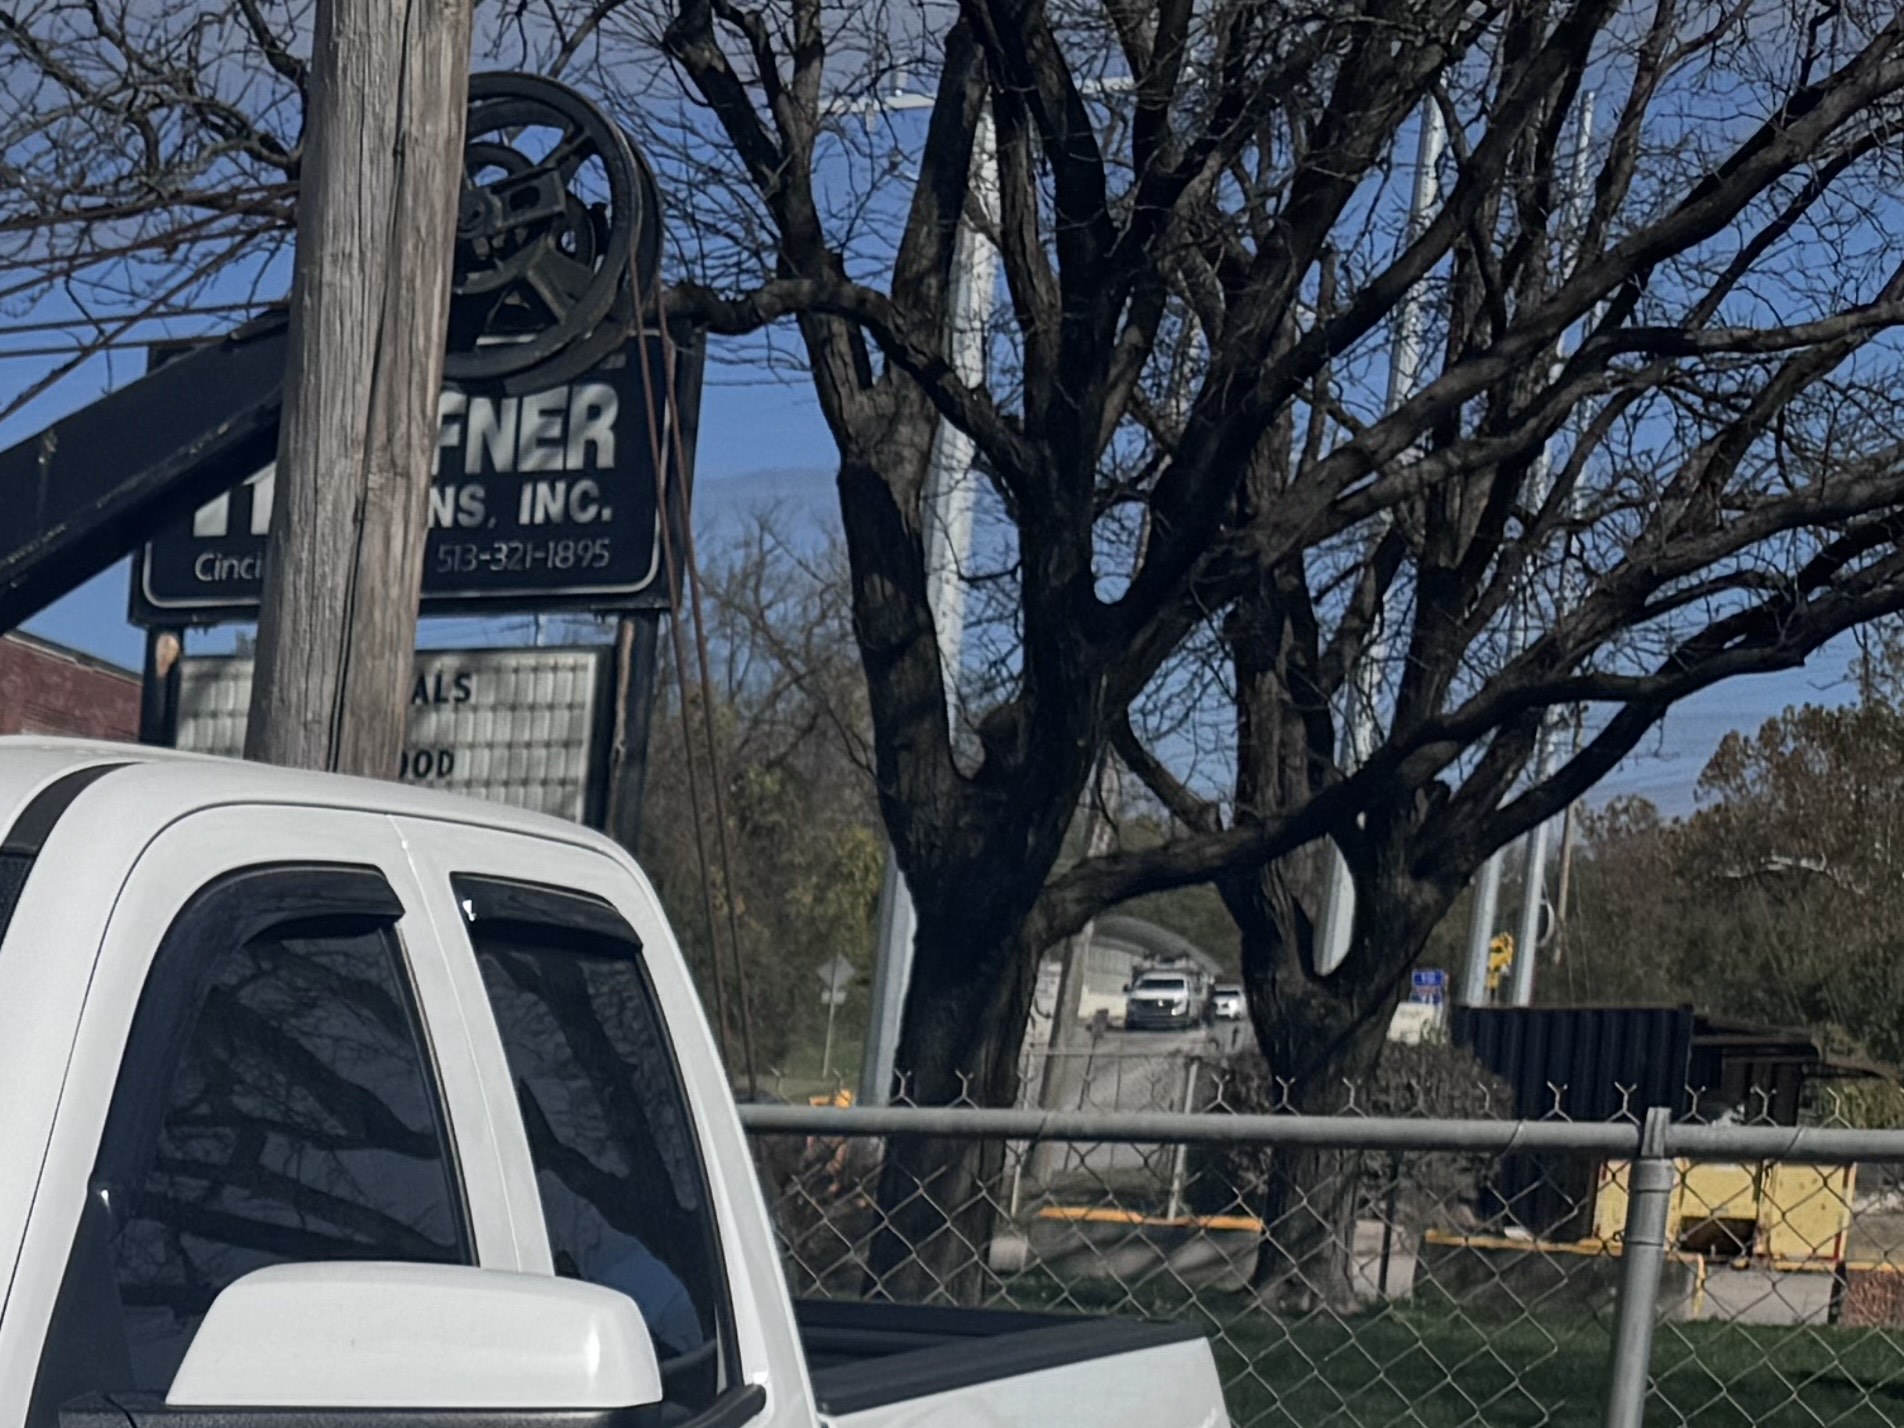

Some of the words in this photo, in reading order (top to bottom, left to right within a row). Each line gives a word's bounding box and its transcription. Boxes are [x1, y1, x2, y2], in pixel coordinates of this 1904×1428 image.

[433, 384, 619, 474] FNER
[518, 478, 614, 526] INC.
[195, 551, 265, 583] Cinci
[435, 536, 612, 574] 513-321-1895
[410, 671, 473, 706] ALS
[398, 748, 456, 780] OD
